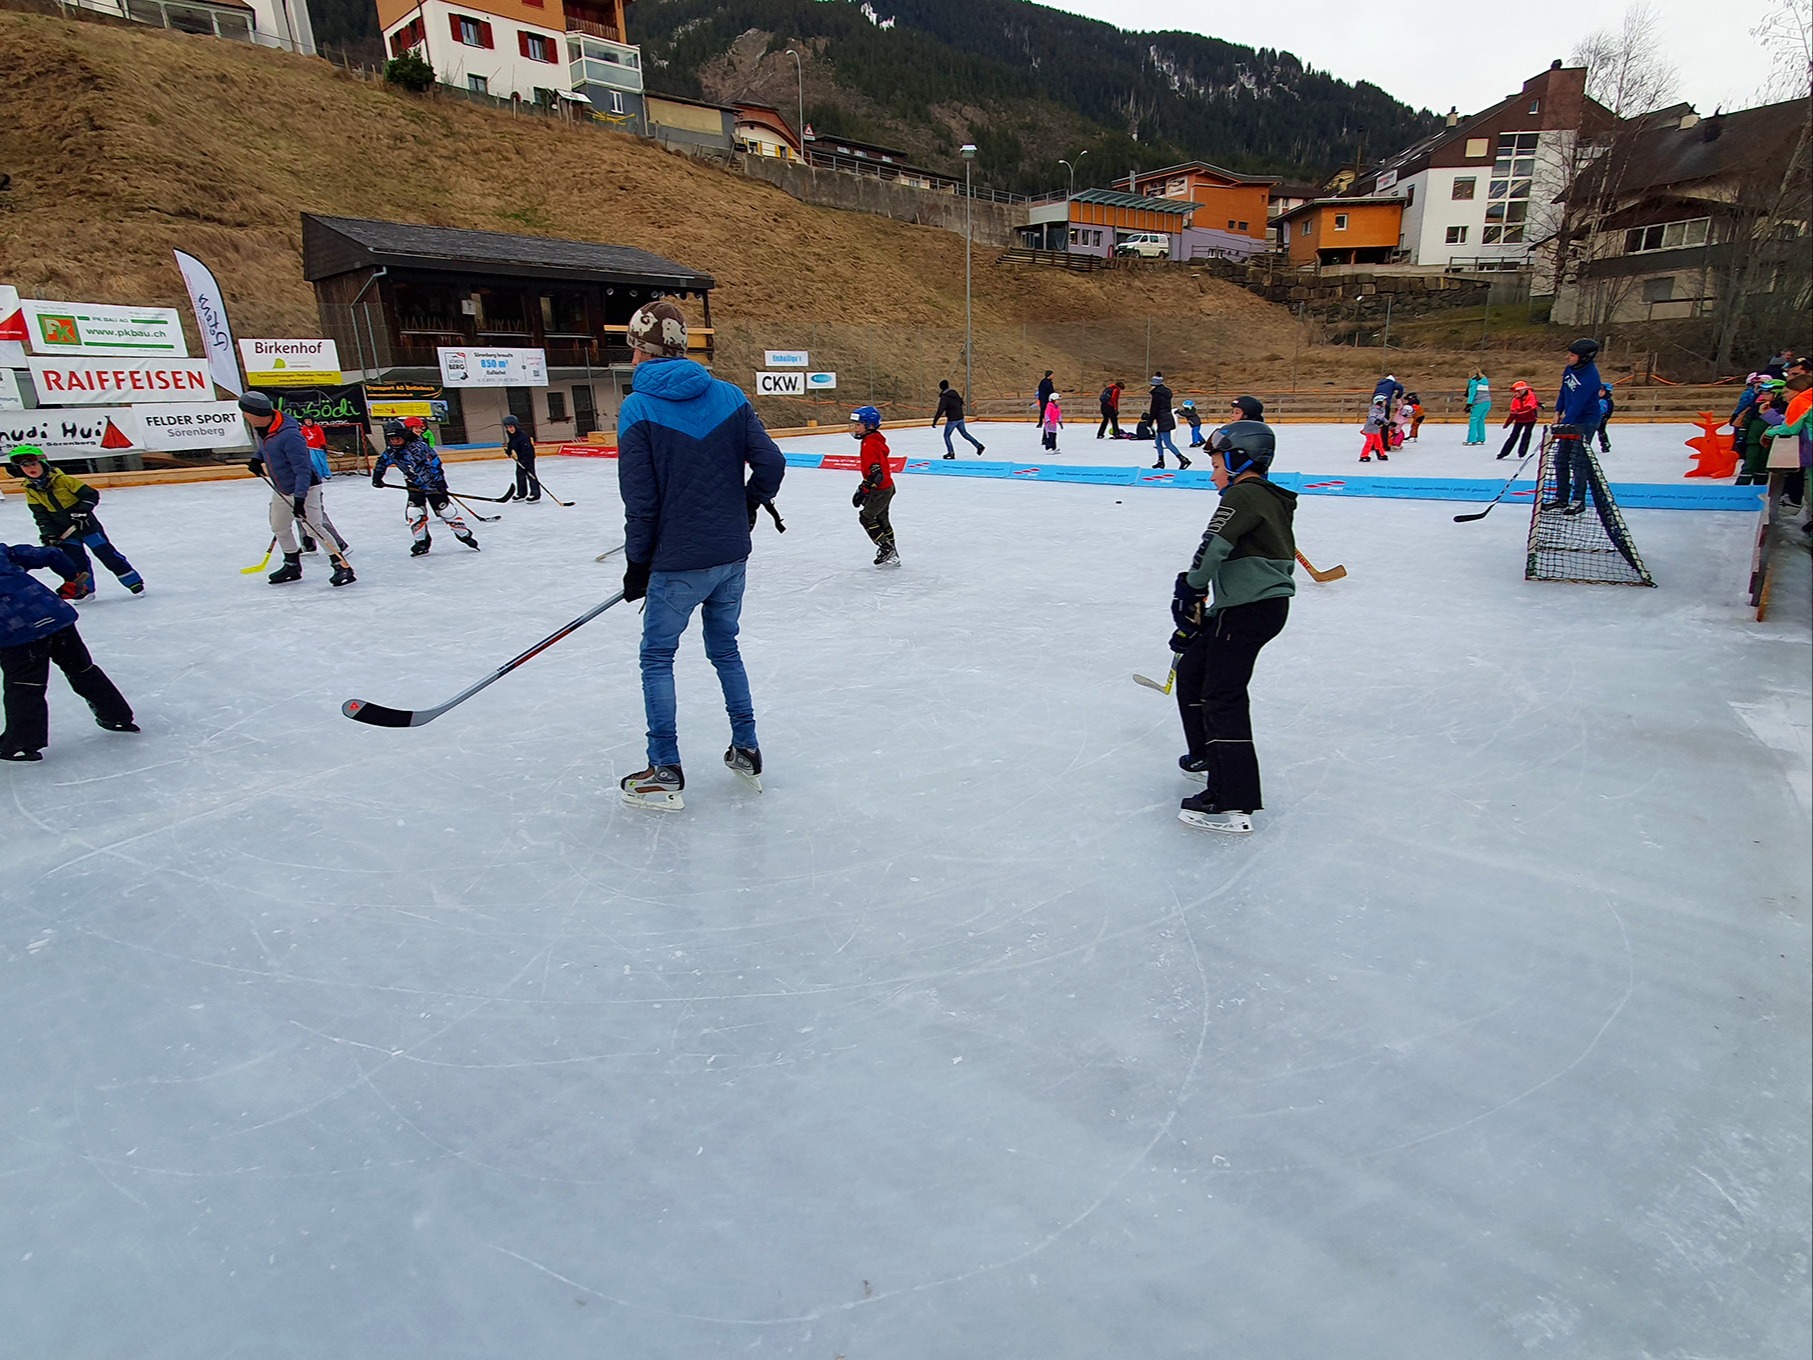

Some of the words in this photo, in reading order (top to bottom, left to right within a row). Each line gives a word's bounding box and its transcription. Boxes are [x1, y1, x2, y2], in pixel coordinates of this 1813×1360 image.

[86, 328, 167, 338] www.pkbau.ch
[254, 341, 323, 354] Birkenhof
[480, 359, 497, 368] 850
[42, 369, 206, 391] RAIFFEISEN
[146, 414, 193, 427] FELDER
[196, 413, 237, 424] SPORT
[62, 421, 102, 438] Hui
[167, 427, 226, 438] Sörenberg
